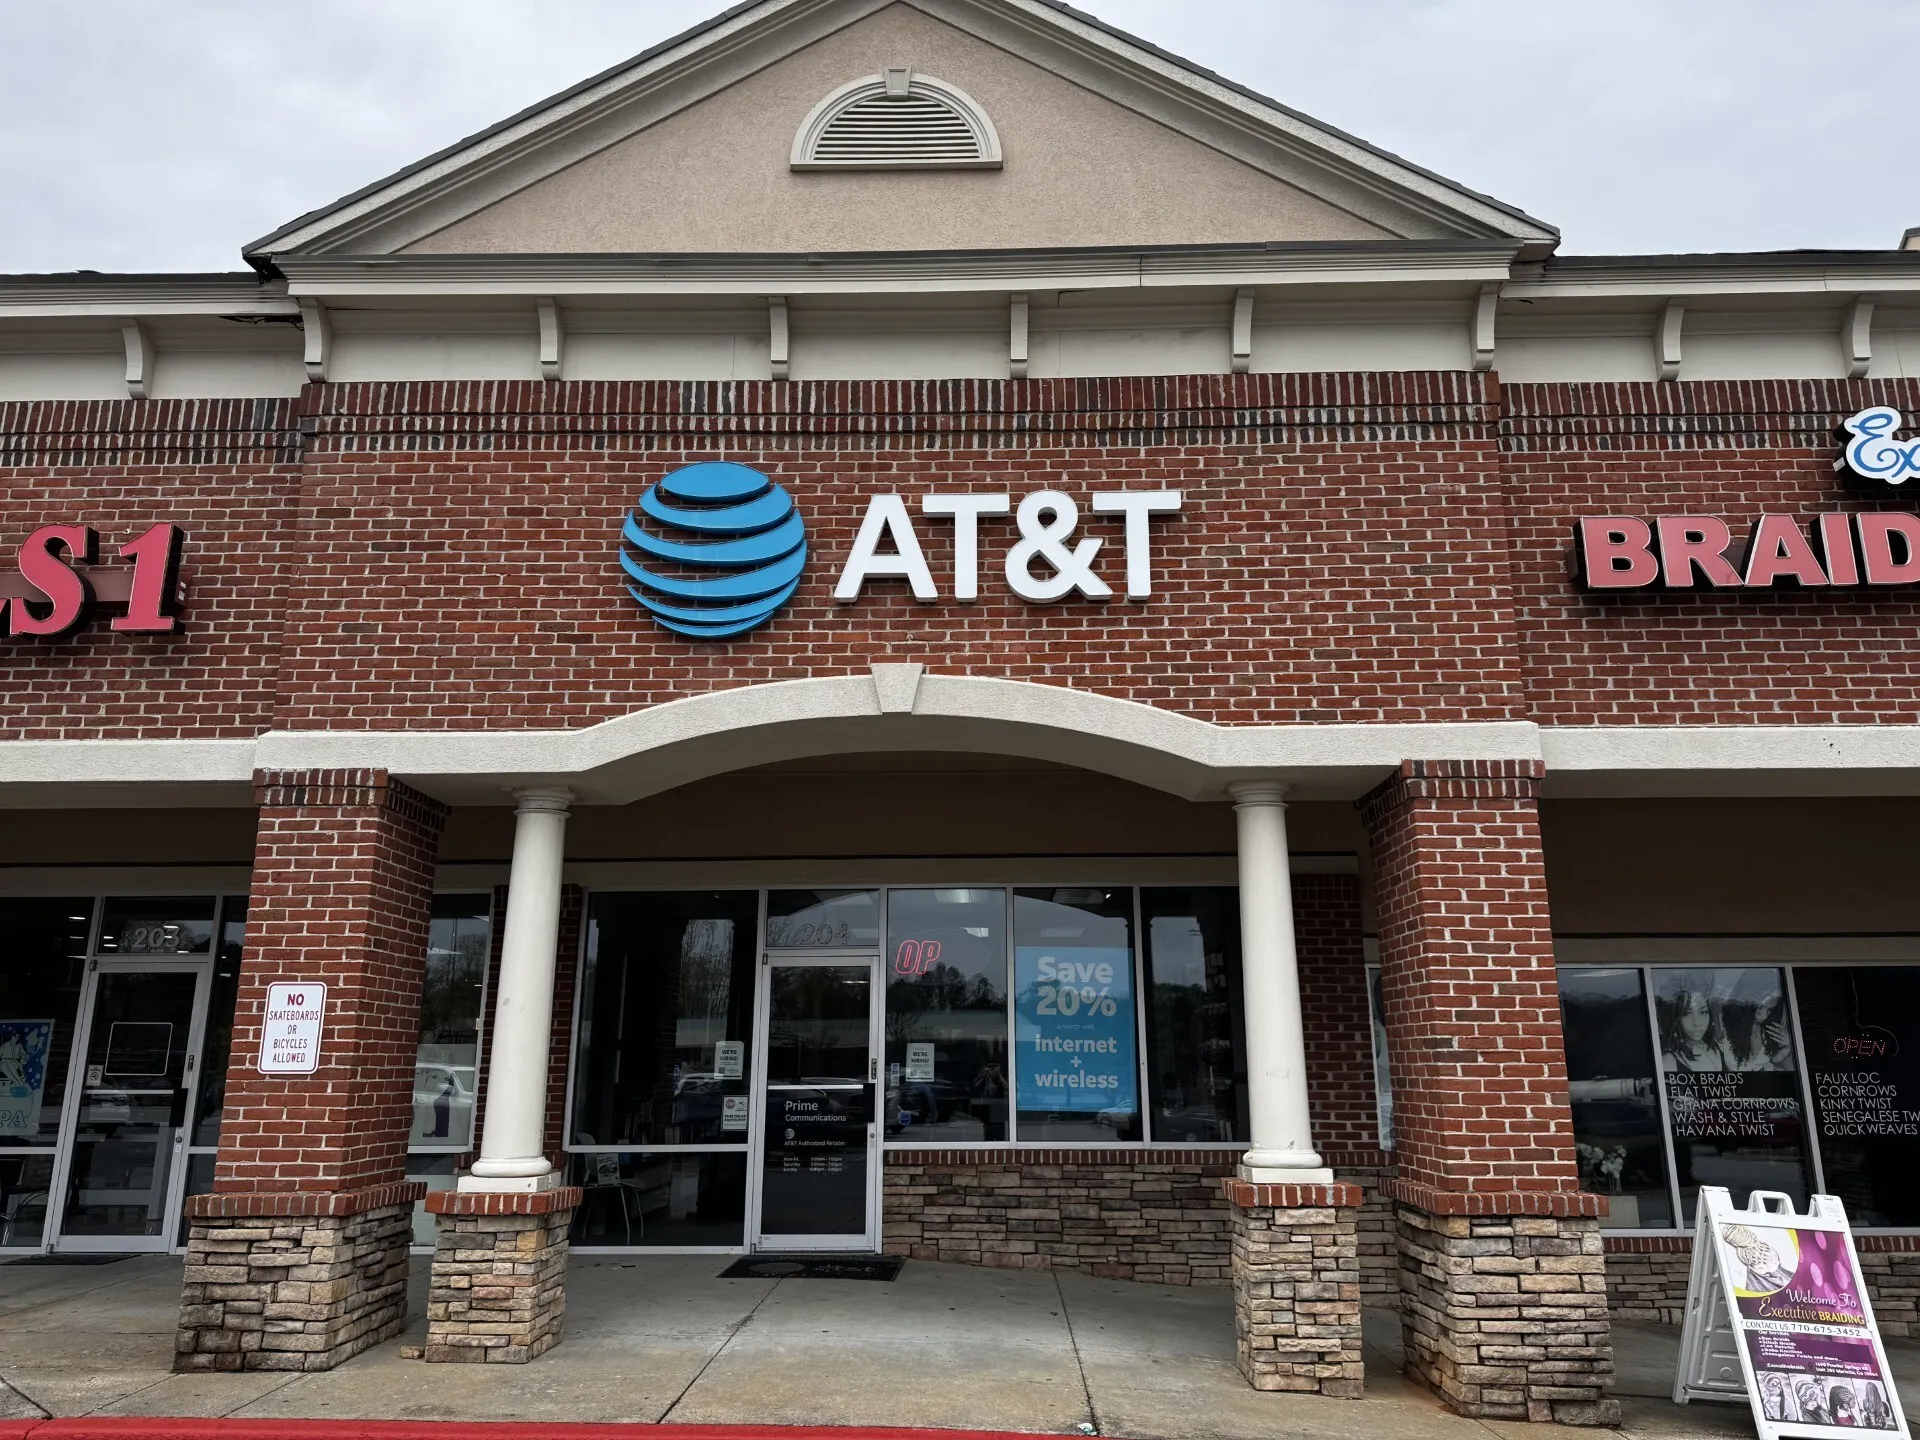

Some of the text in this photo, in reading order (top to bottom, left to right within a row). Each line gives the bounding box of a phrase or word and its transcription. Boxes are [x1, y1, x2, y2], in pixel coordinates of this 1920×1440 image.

[1851, 412, 1920, 478] Ex
[832, 489, 1182, 604] AT&T
[1579, 512, 1920, 588] BRAID
[0, 521, 180, 637] S 1
[131, 926, 181, 948] 203
[799, 923, 851, 945] 204
[895, 939, 941, 975] OP
[1037, 955, 1114, 984] Save
[287, 993, 305, 1006] NO
[1036, 985, 1117, 1017] 20%
[268, 1010, 320, 1021] SKATEBOARDS
[287, 1024, 297, 1035] OR
[273, 1038, 308, 1049] BICYCLES
[1035, 1034, 1118, 1053] internet
[1833, 1037, 1886, 1056] OPEN
[272, 1052, 305, 1063] ALLOWED
[1034, 1069, 1119, 1089] wireless
[1669, 1073, 1744, 1085] BOX BRAIDS
[1815, 1072, 1881, 1084] FAUX LOC
[1671, 1085, 1737, 1097] FLAT TWIST
[1818, 1085, 1897, 1097] CORNROWS
[785, 1100, 818, 1111] Prime
[1673, 1097, 1795, 1110] GHANA CORNROWS
[1820, 1098, 1892, 1110] KINKY TWIST
[785, 1113, 847, 1122] Communications
[1674, 1111, 1766, 1124] WASH & STYLE
[1822, 1110, 1920, 1123] SENEGALESE TW
[1676, 1123, 1775, 1136] HAVANA TWIST
[1824, 1123, 1918, 1136] QUICK WEAVES
[1786, 1288, 1857, 1308] Welcome To
[1758, 1296, 1865, 1325] Executive BRAIDING
[1745, 1320, 1778, 1330] CONTACT
[1790, 1323, 1861, 1336] 770-675-3452
